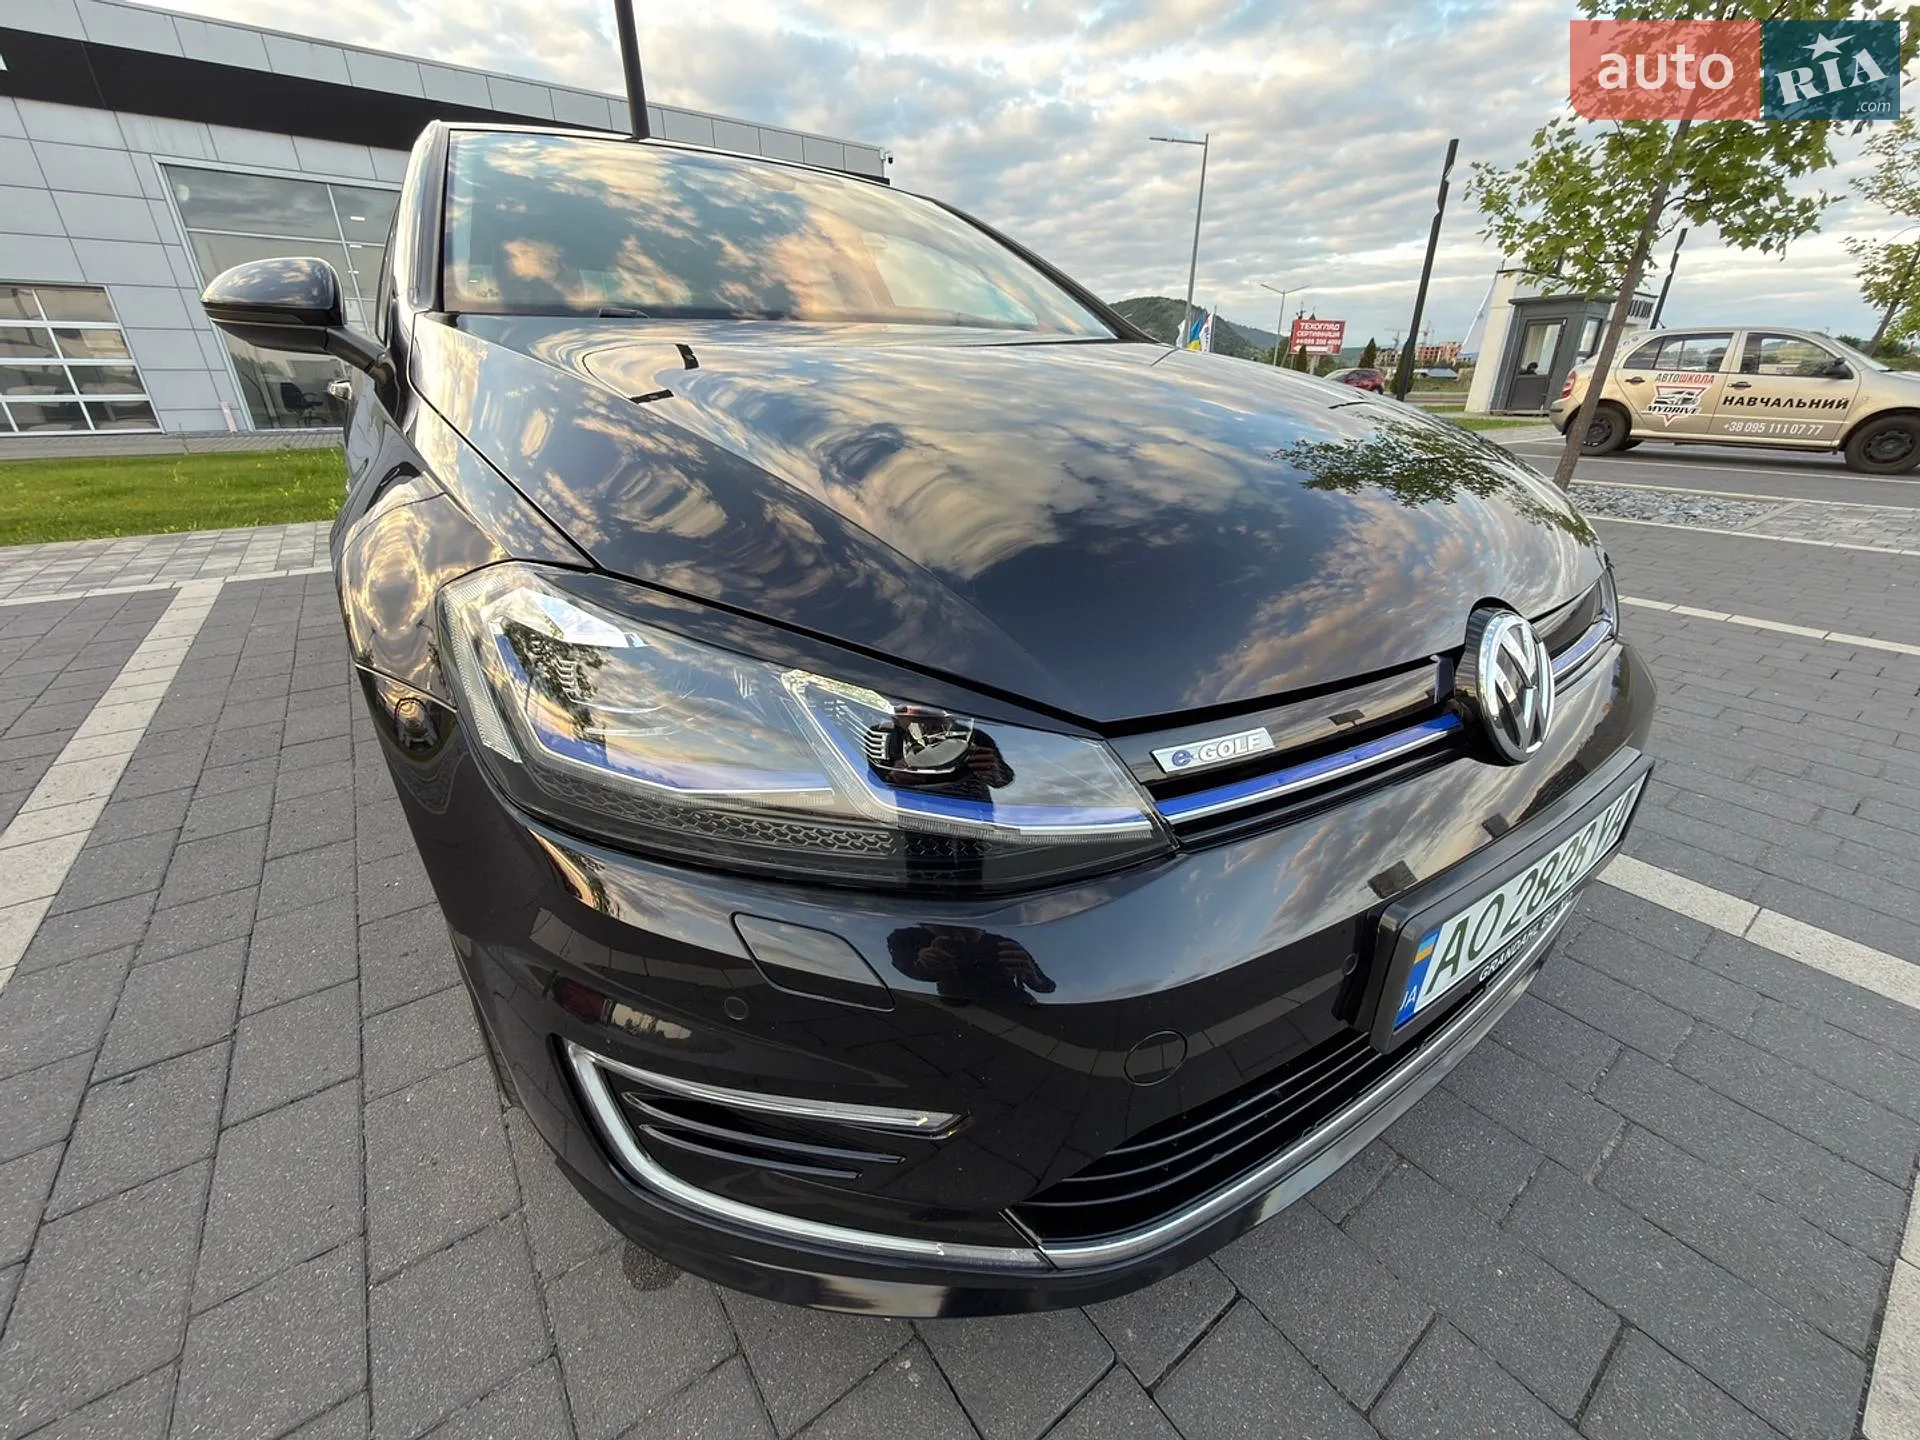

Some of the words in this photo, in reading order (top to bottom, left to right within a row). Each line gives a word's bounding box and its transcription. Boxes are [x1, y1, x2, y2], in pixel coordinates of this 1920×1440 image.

[1655, 373, 1715, 384] АВТОШКОЛА
[1722, 396, 1849, 409] НАВЧАЛЬНИЙ
[1724, 421, 1745, 432] +38
[1744, 422, 1766, 433] 095
[1768, 424, 1788, 433] 111
[1789, 424, 1807, 434] 07
[1806, 425, 1824, 435] 77
